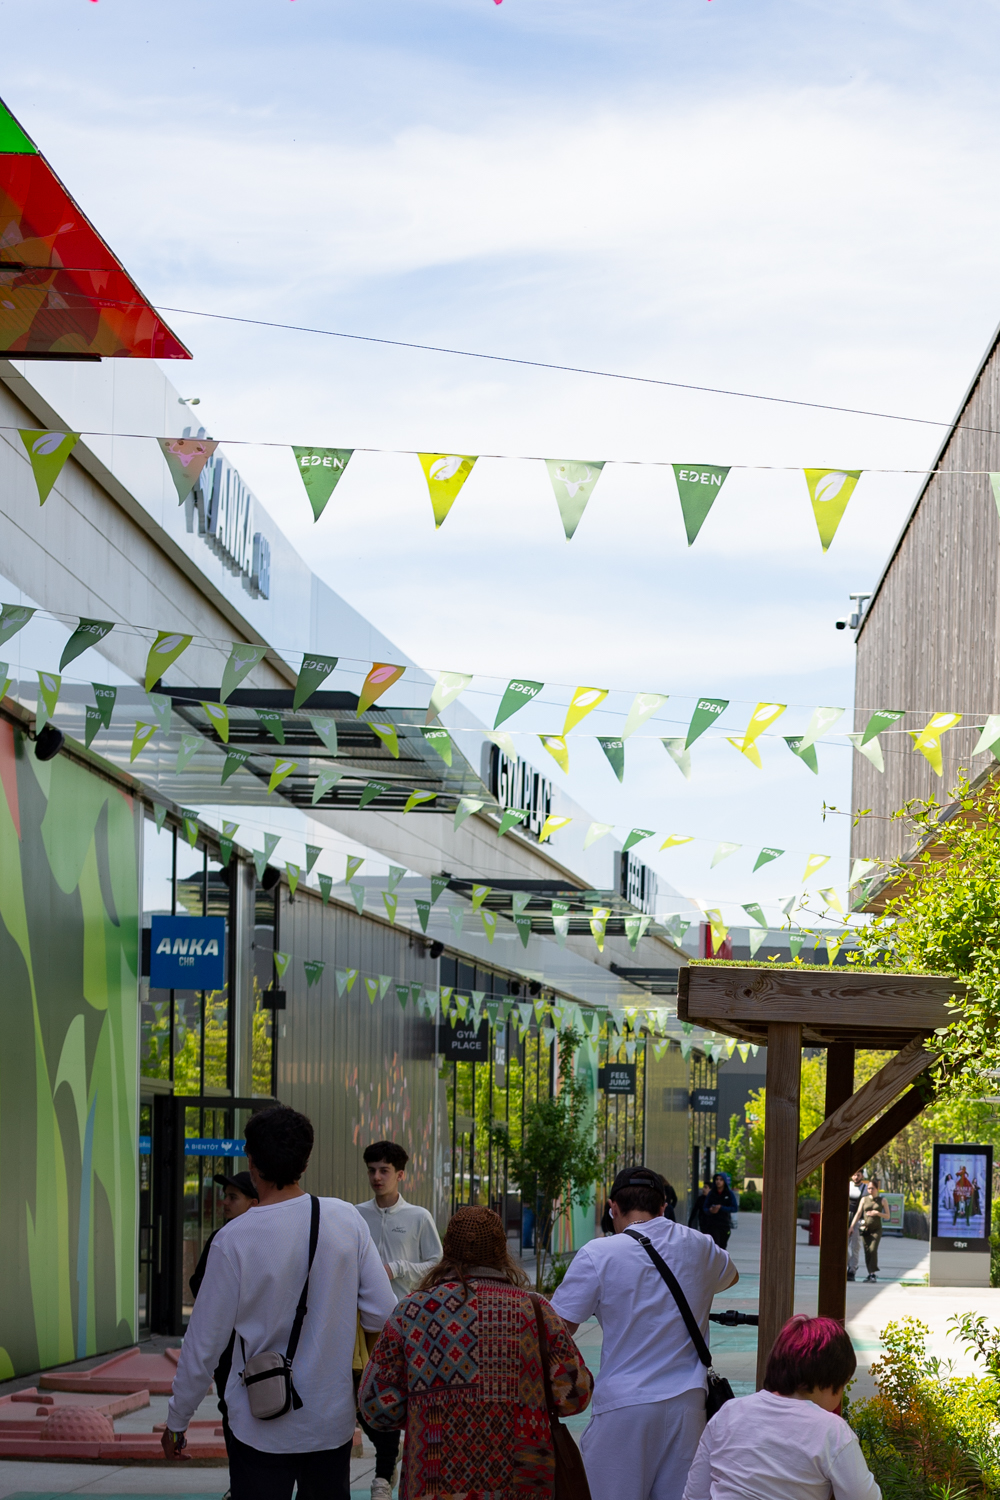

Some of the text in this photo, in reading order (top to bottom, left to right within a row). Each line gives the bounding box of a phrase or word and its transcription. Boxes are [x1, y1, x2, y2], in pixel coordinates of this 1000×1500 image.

[300, 455, 345, 469] EDEN
[678, 469, 722, 486] EDEN
[77, 624, 107, 637] EDEN
[302, 660, 333, 674] EDEN
[508, 682, 538, 697] EDEN
[697, 701, 724, 715] EDEN
[87, 710, 101, 720] EDE
[227, 751, 248, 762] EDEN
[367, 782, 387, 792] EDEN
[505, 809, 527, 819] EDEN
[156, 937, 219, 957] ANKA
[178, 956, 195, 967] CHR
[456, 1030, 478, 1039] GYM
[451, 1041, 482, 1050] PLACE
[610, 1071, 630, 1079] FEEL
